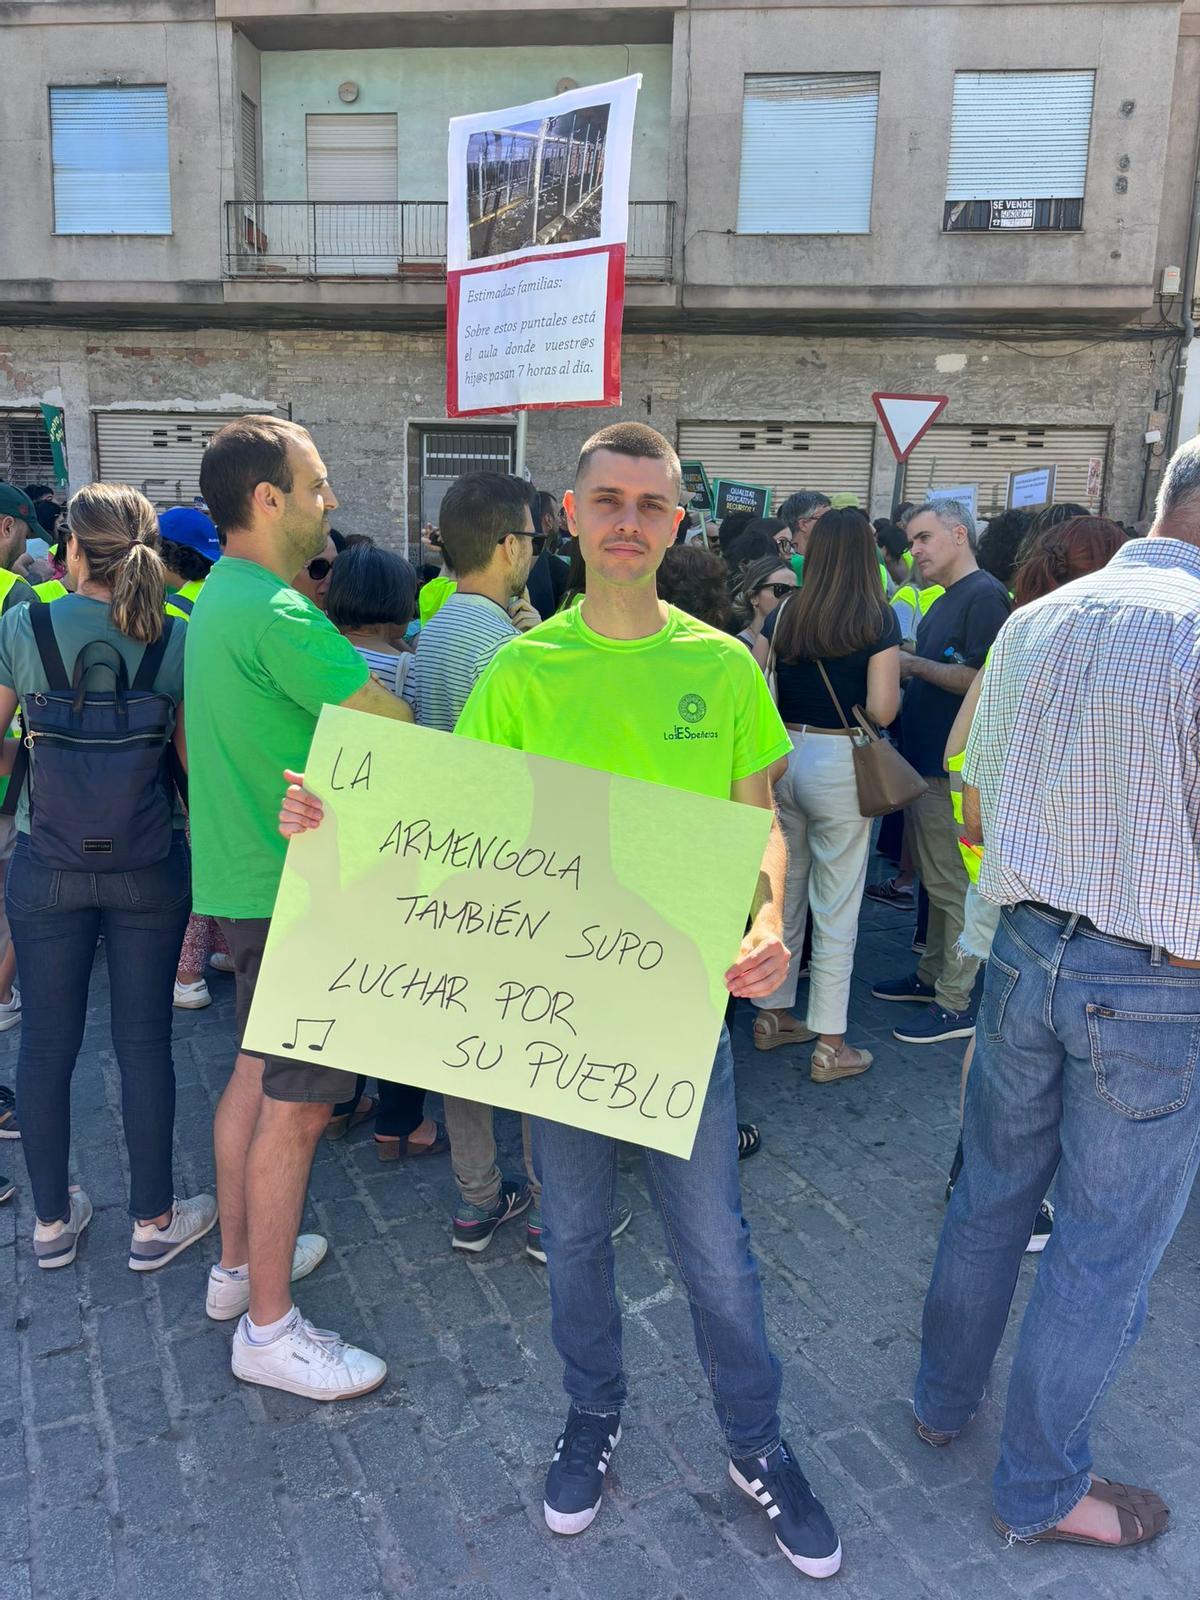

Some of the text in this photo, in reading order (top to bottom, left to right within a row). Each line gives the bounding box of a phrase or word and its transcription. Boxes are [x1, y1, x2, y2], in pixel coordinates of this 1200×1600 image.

[993, 201, 1033, 209] SE VENDE
[467, 276, 563, 303] Estimadas familias:
[464, 310, 597, 339] Sobre estos puntales está
[464, 337, 595, 362] el aula donde vuestr@s
[464, 359, 593, 387] hij@s pasan 7 horas al día.
[330, 746, 372, 791] LA
[378, 818, 582, 891] ARMENGOLA
[564, 924, 664, 971] SUPO
[327, 957, 578, 1037] LUCHAR POR
[441, 1035, 696, 1119] SU PUEBLO
